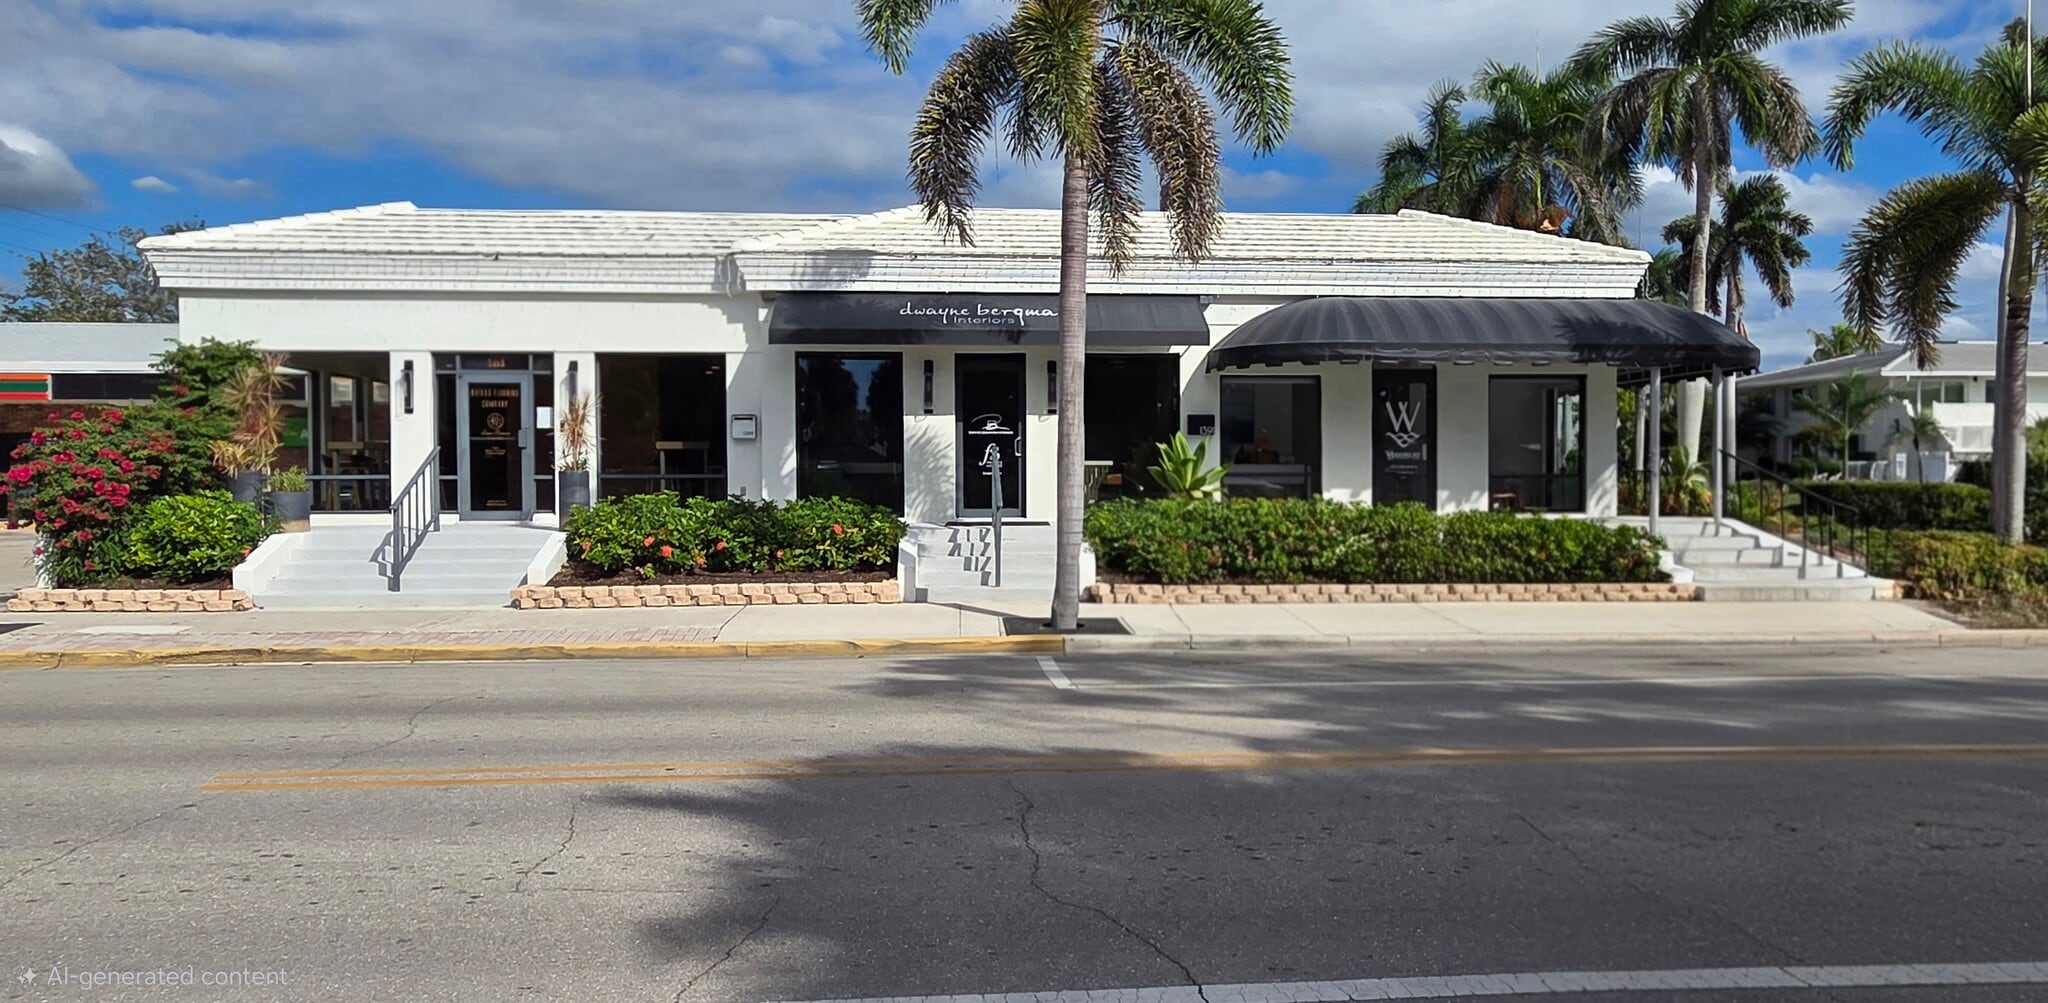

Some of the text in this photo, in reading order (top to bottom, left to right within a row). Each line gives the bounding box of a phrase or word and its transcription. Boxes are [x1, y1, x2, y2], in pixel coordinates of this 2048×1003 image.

[899, 302, 1058, 326] dwayne bergma
[953, 316, 1016, 324] Interiors
